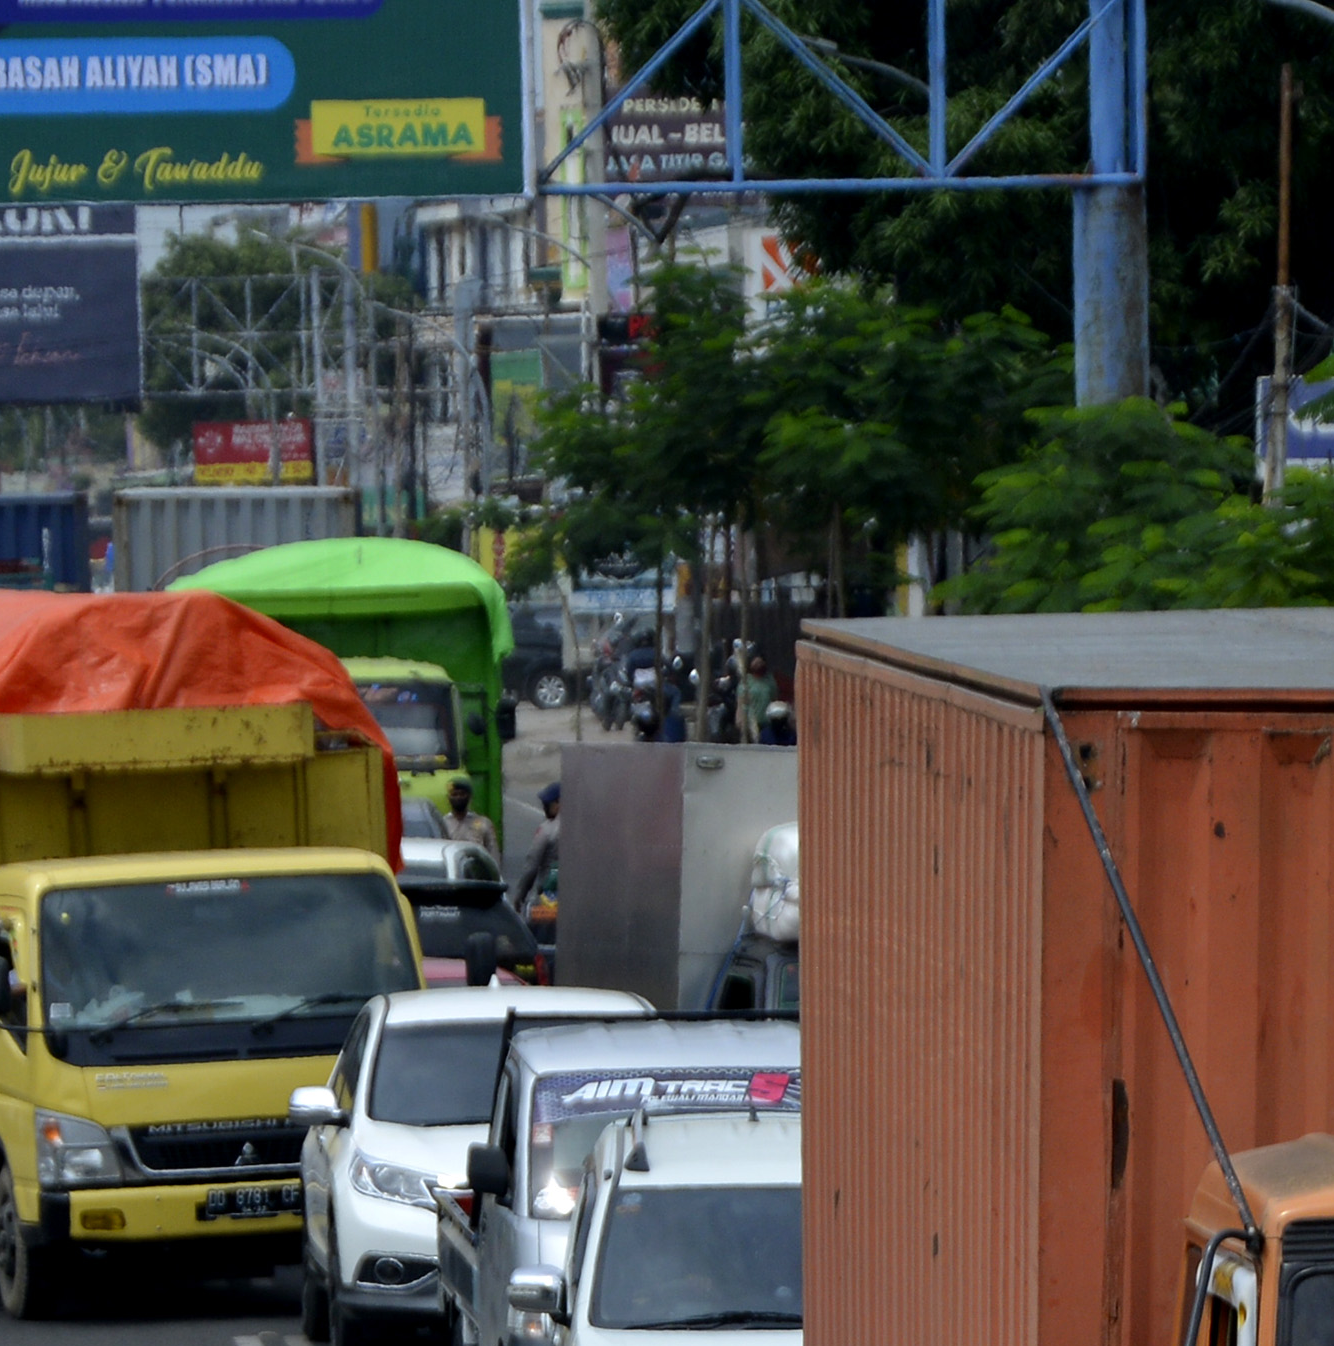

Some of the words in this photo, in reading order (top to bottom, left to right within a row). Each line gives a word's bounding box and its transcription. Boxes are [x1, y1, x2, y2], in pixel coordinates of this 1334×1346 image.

[86, 55, 179, 88] ALIYAH
[185, 54, 268, 87] (SMA)
[364, 105, 441, 118] Tersedia
[333, 122, 473, 149] ASRAMA
[684, 123, 727, 144] BEL
[10, 149, 87, 195] Jujur
[98, 149, 128, 184] &
[134, 147, 264, 190] Tawaddu
